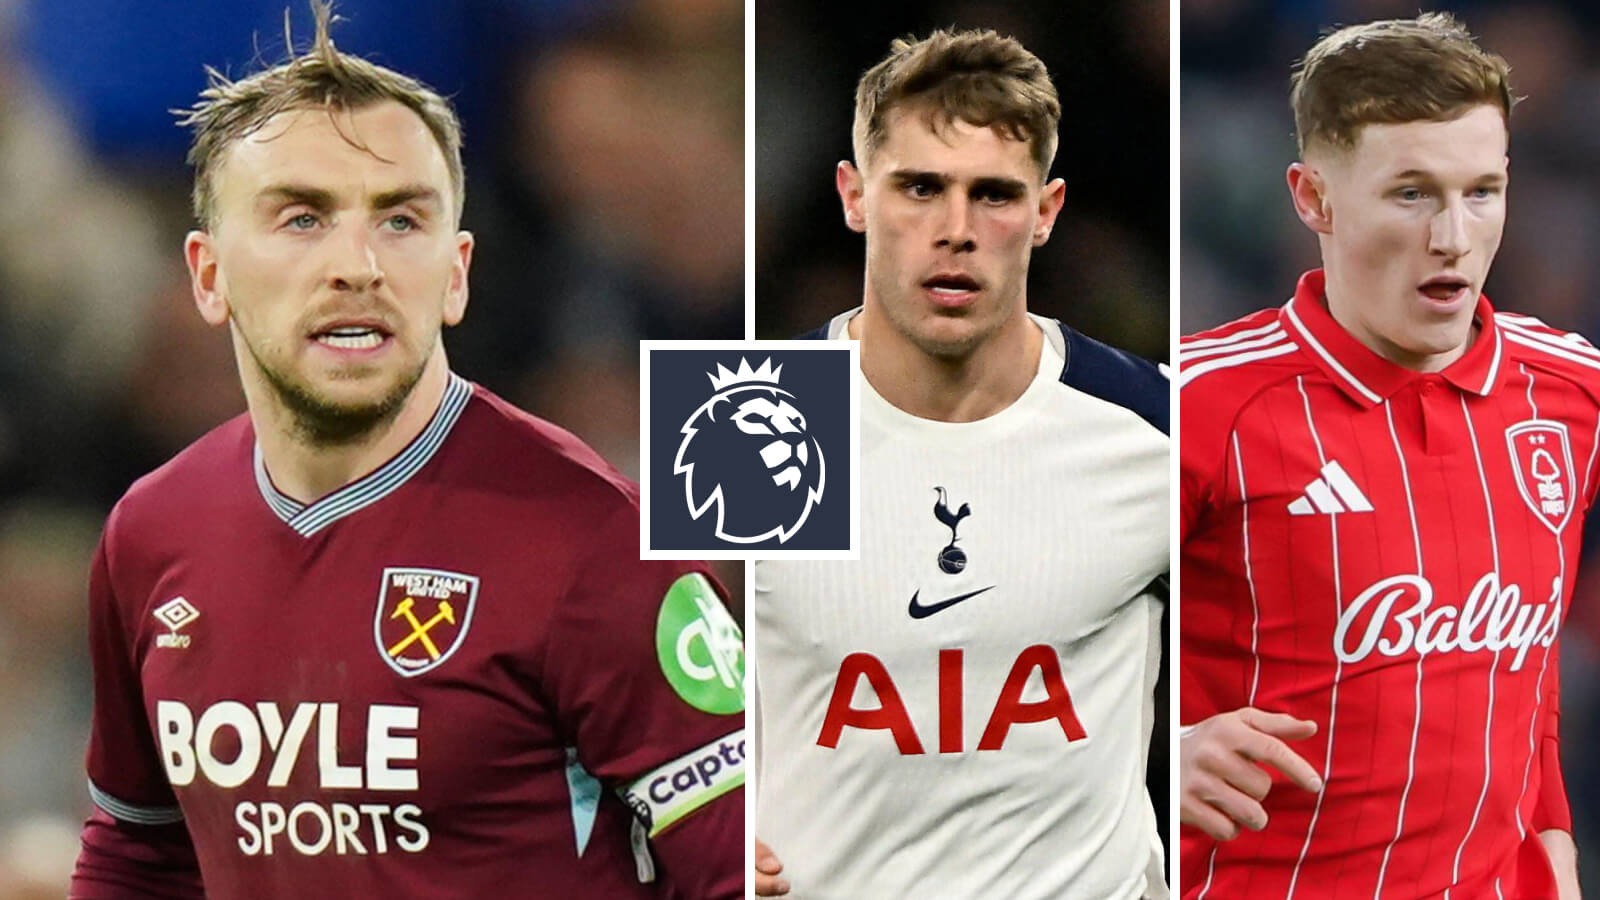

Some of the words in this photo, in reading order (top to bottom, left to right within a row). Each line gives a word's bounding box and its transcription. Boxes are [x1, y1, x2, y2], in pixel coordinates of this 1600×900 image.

[392, 574, 431, 588] WEST
[432, 576, 467, 594] HAM
[406, 585, 451, 599] UNITED
[1333, 571, 1561, 672] Bally's
[815, 643, 1088, 756] AIA
[157, 700, 420, 792] BOYLE
[235, 801, 430, 856] SPORTS
